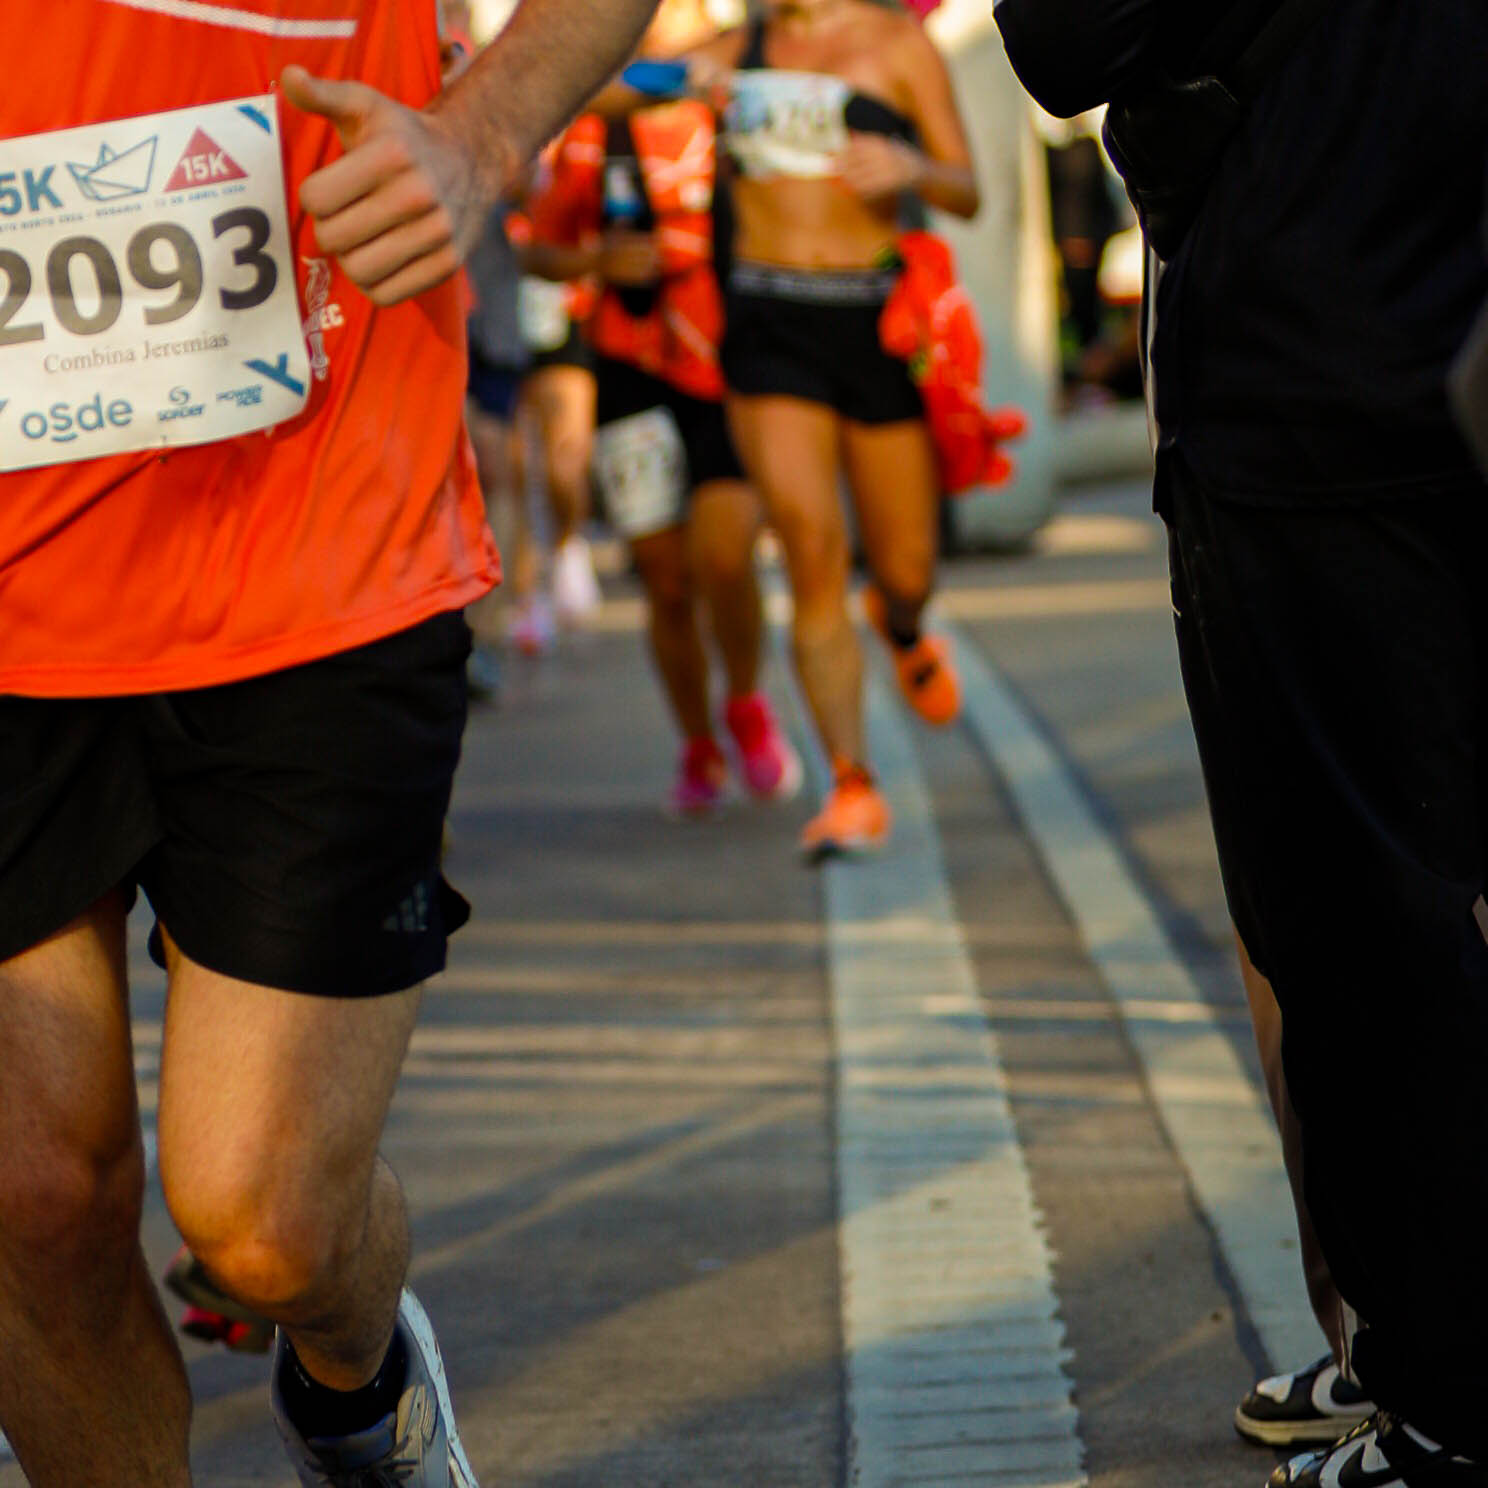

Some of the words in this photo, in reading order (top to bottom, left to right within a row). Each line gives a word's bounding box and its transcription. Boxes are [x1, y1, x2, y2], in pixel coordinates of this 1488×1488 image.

[179, 149, 231, 184] 15K
[43, 344, 136, 375] Combina
[21, 394, 134, 442] osde
